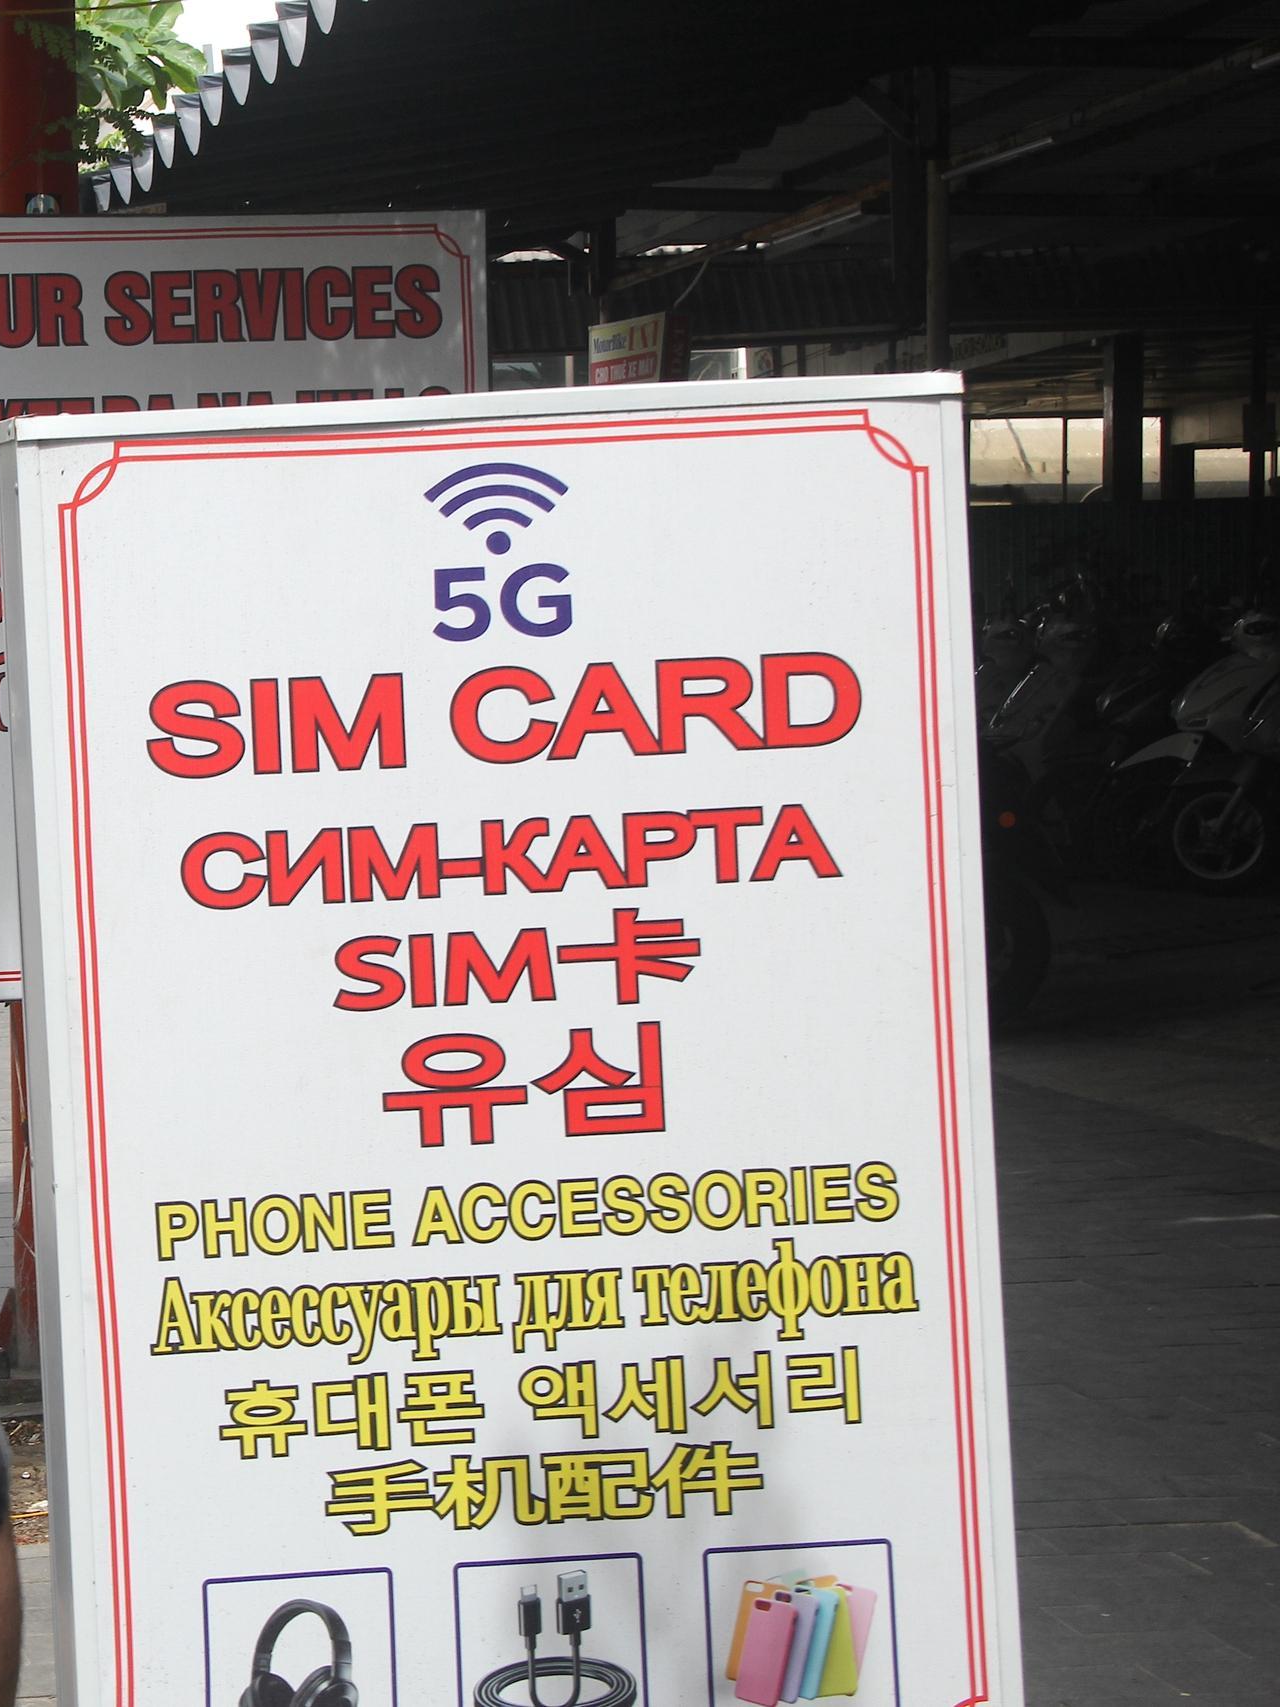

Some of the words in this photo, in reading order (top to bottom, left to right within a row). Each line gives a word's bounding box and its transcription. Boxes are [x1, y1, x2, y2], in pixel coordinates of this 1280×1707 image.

[104, 263, 443, 348] SERVICES
[432, 563, 573, 642] 5G
[146, 672, 407, 780] SIM
[448, 650, 863, 764] CARD
[180, 803, 843, 909] СИМ-КАРТА
[332, 907, 701, 1012] SIM卡
[382, 1020, 666, 1148] 유심
[155, 1190, 395, 1261] PHONE
[411, 1160, 900, 1247] ACCESSORIES
[151, 1274, 501, 1365] Аксессуары
[513, 1264, 622, 1350] для
[634, 1237, 919, 1341] телефона
[218, 1371, 486, 1460] 휴대폰
[517, 1346, 862, 1440] 액세서리
[325, 1442, 764, 1536] 手机配件
